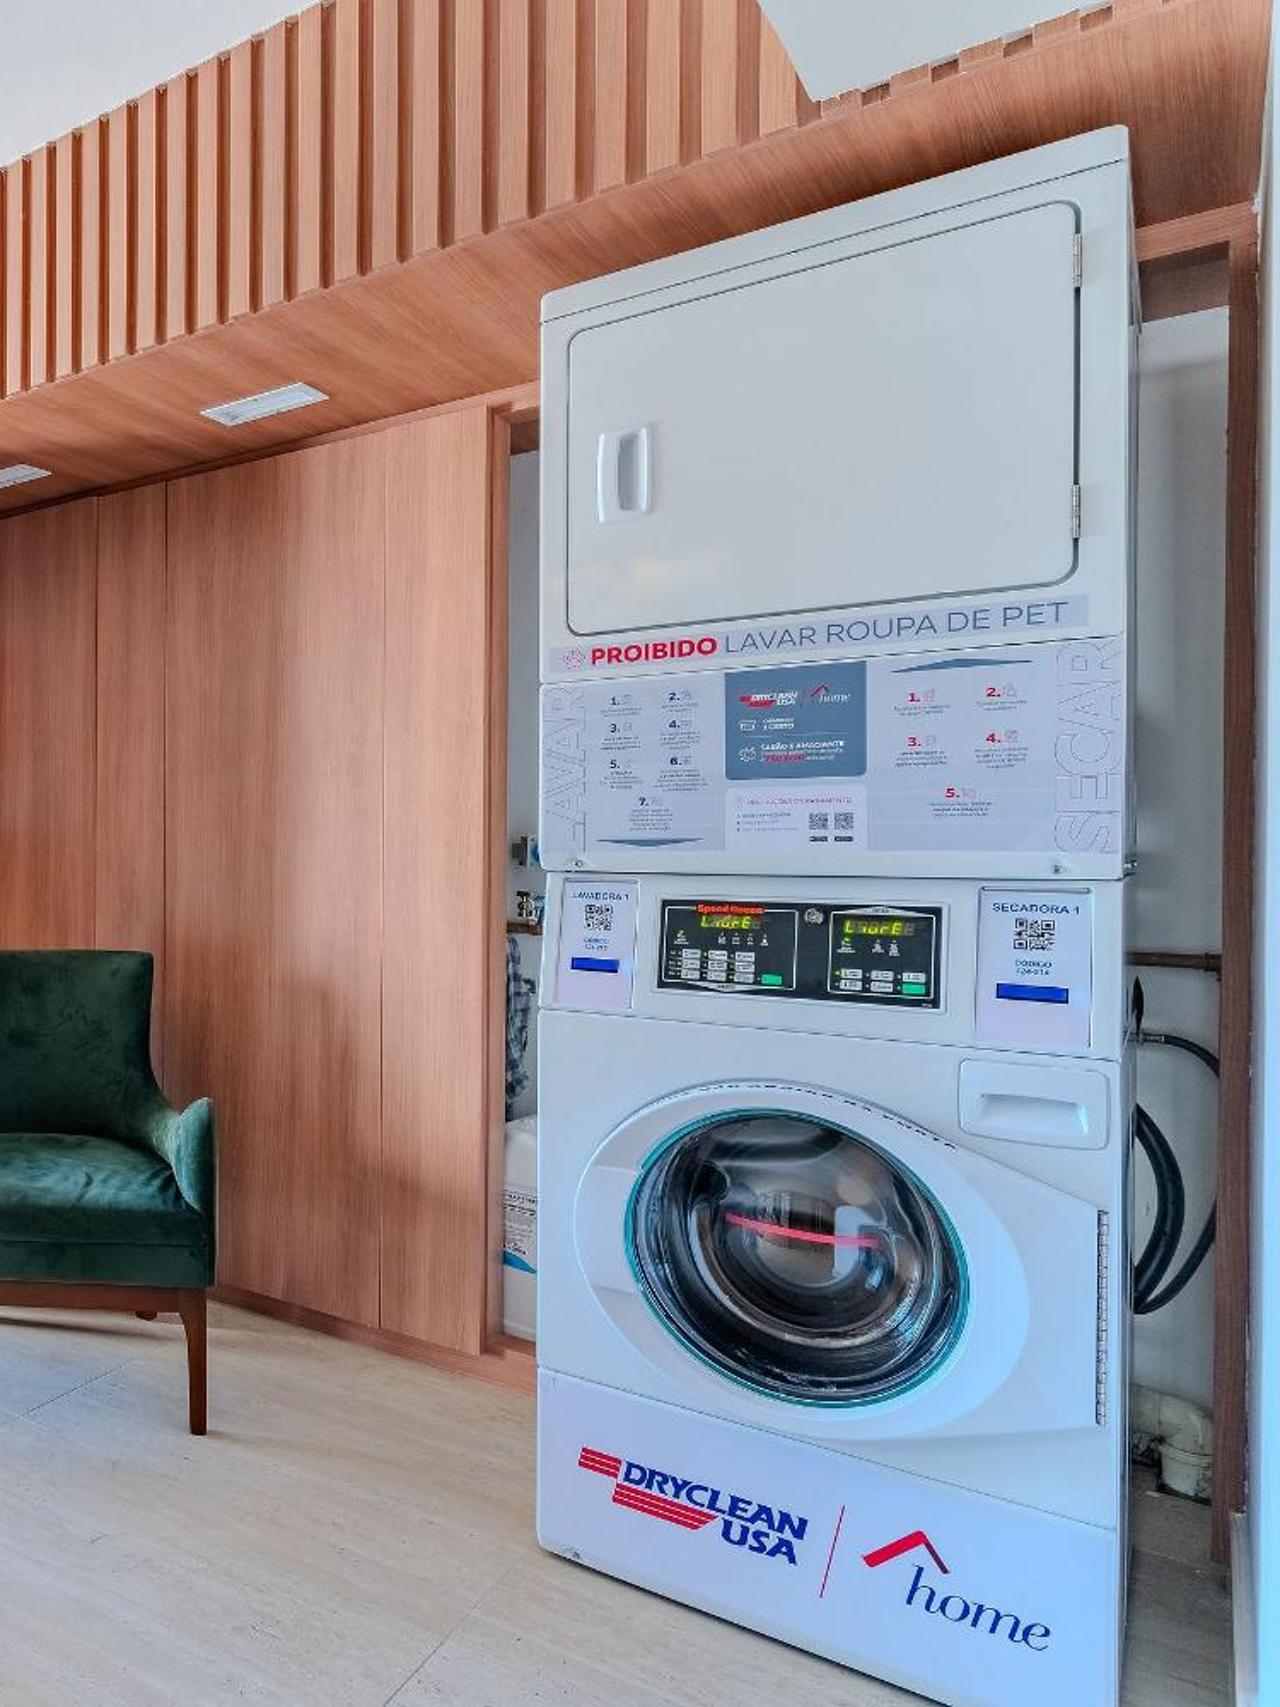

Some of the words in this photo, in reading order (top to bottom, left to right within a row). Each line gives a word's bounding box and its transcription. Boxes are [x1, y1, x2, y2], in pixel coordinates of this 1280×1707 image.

[591, 637, 717, 666] PROIBIDO
[725, 627, 817, 654] LAVAR
[827, 615, 938, 644] ROUPA
[948, 608, 990, 633] DE
[1003, 601, 1070, 627] PET
[908, 693, 920, 702] 1.
[986, 687, 1001, 697] 2.
[907, 737, 921, 747] 3.
[985, 733, 1001, 743] 4.
[945, 788, 960, 798] 5.
[992, 902, 1070, 914] SECADORA
[623, 1460, 808, 1540] DRYCLEAN
[722, 1517, 797, 1565] USA
[906, 1564, 1051, 1651] home
